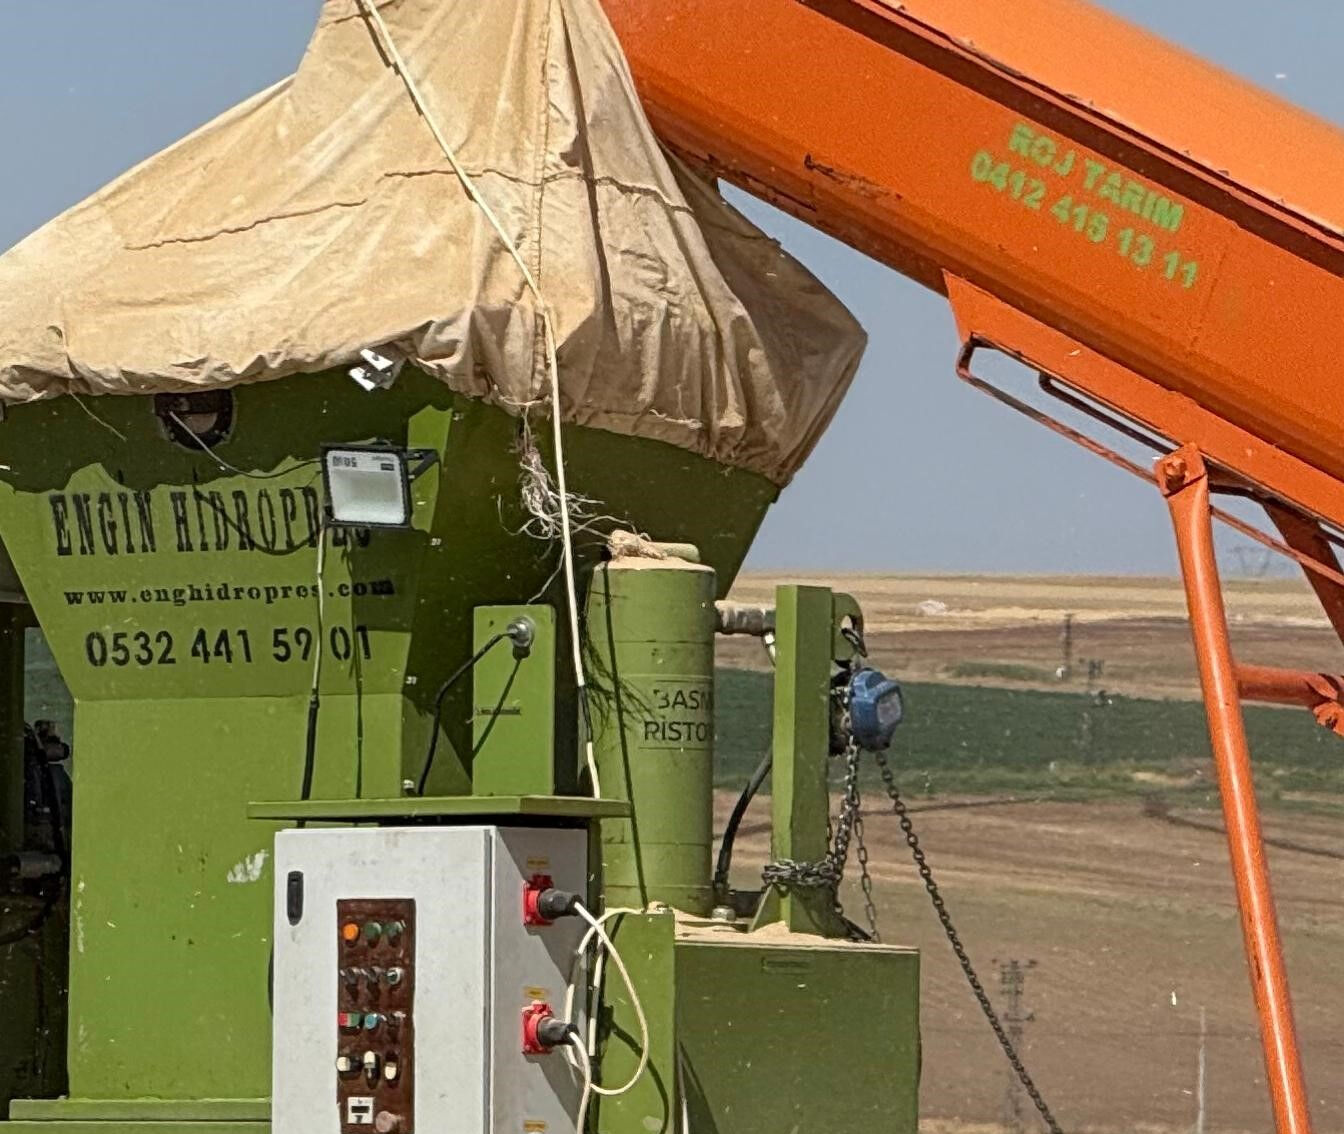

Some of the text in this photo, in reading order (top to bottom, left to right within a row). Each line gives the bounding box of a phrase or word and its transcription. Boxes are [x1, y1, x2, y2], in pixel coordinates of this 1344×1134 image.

[1009, 122, 1184, 232] ROJ TARIM
[971, 150, 1046, 210] 0412
[1118, 227, 1154, 266] 13
[1164, 251, 1198, 289] 11
[63, 578, 395, 606] www.enghidropres.com
[85, 625, 371, 667] 0532 441 59 01
